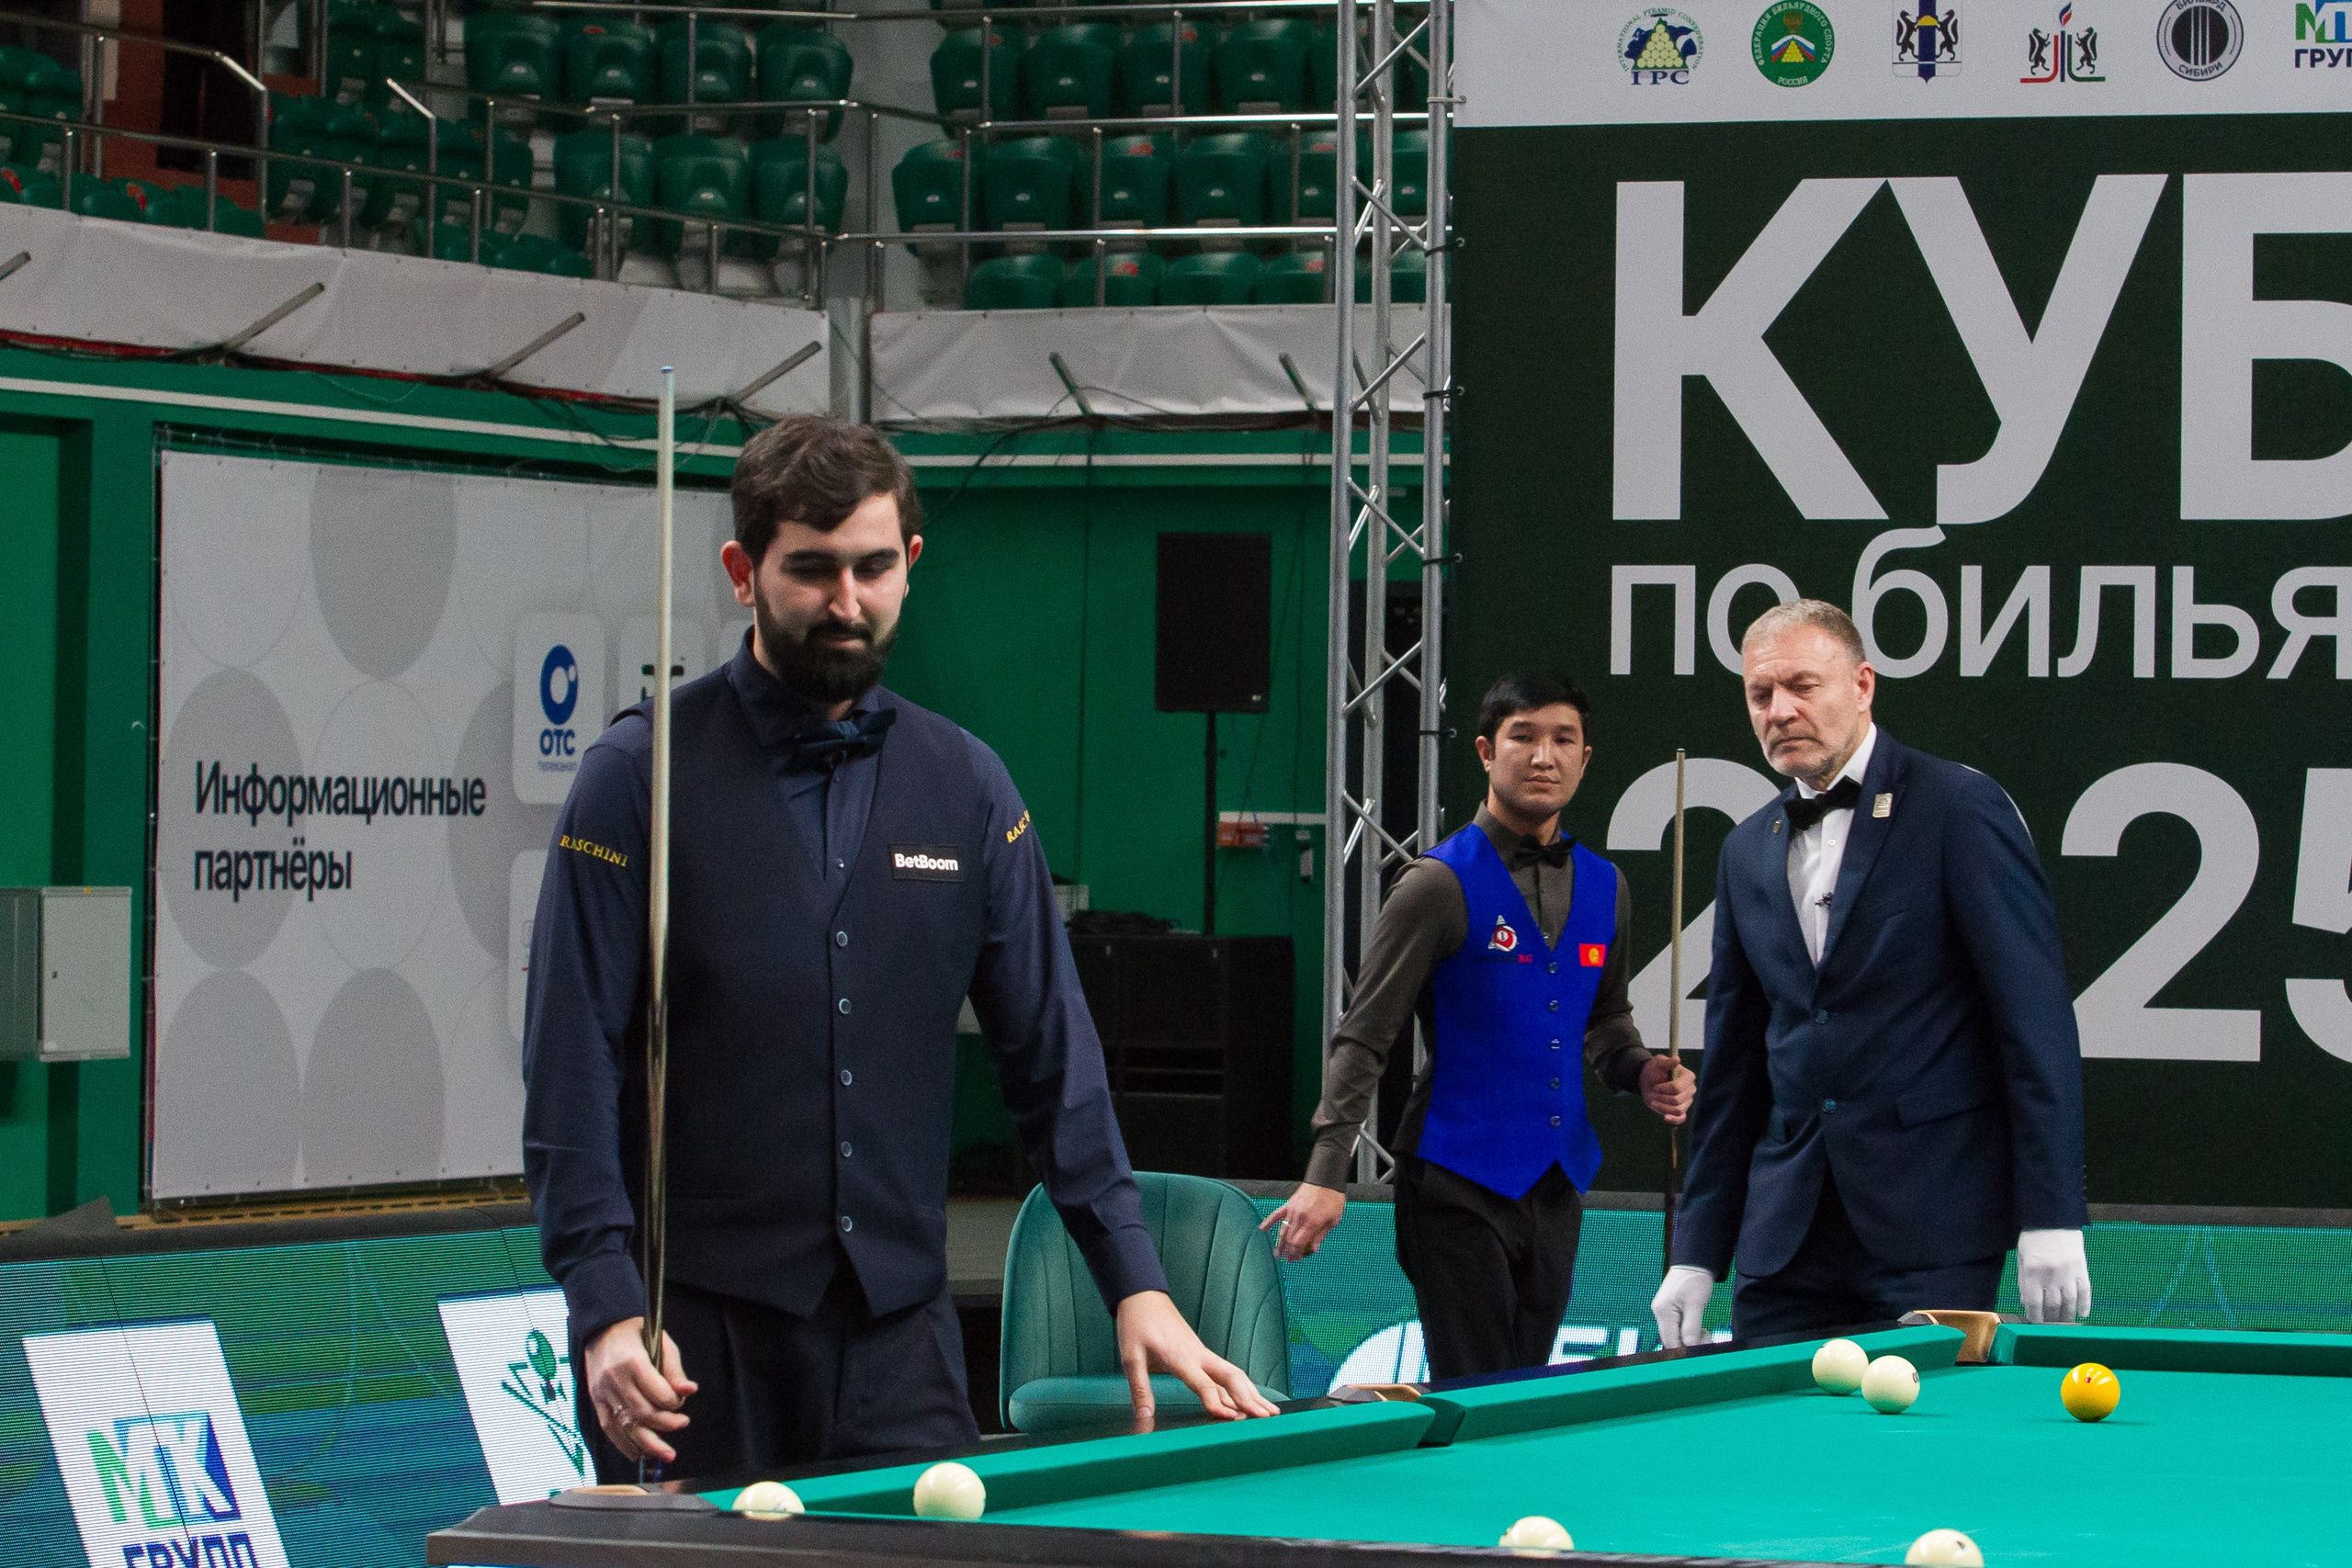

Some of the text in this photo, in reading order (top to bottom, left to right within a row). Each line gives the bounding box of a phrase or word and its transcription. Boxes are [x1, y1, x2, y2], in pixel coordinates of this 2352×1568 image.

[2295, 49, 2352, 68] ГРУ
[1631, 70, 1690, 85] IPC
[2178, 62, 2223, 77] СИБИРИ
[195, 761, 487, 827] Информационные
[193, 837, 353, 902] партнёры
[894, 853, 958, 871] BetBoom
